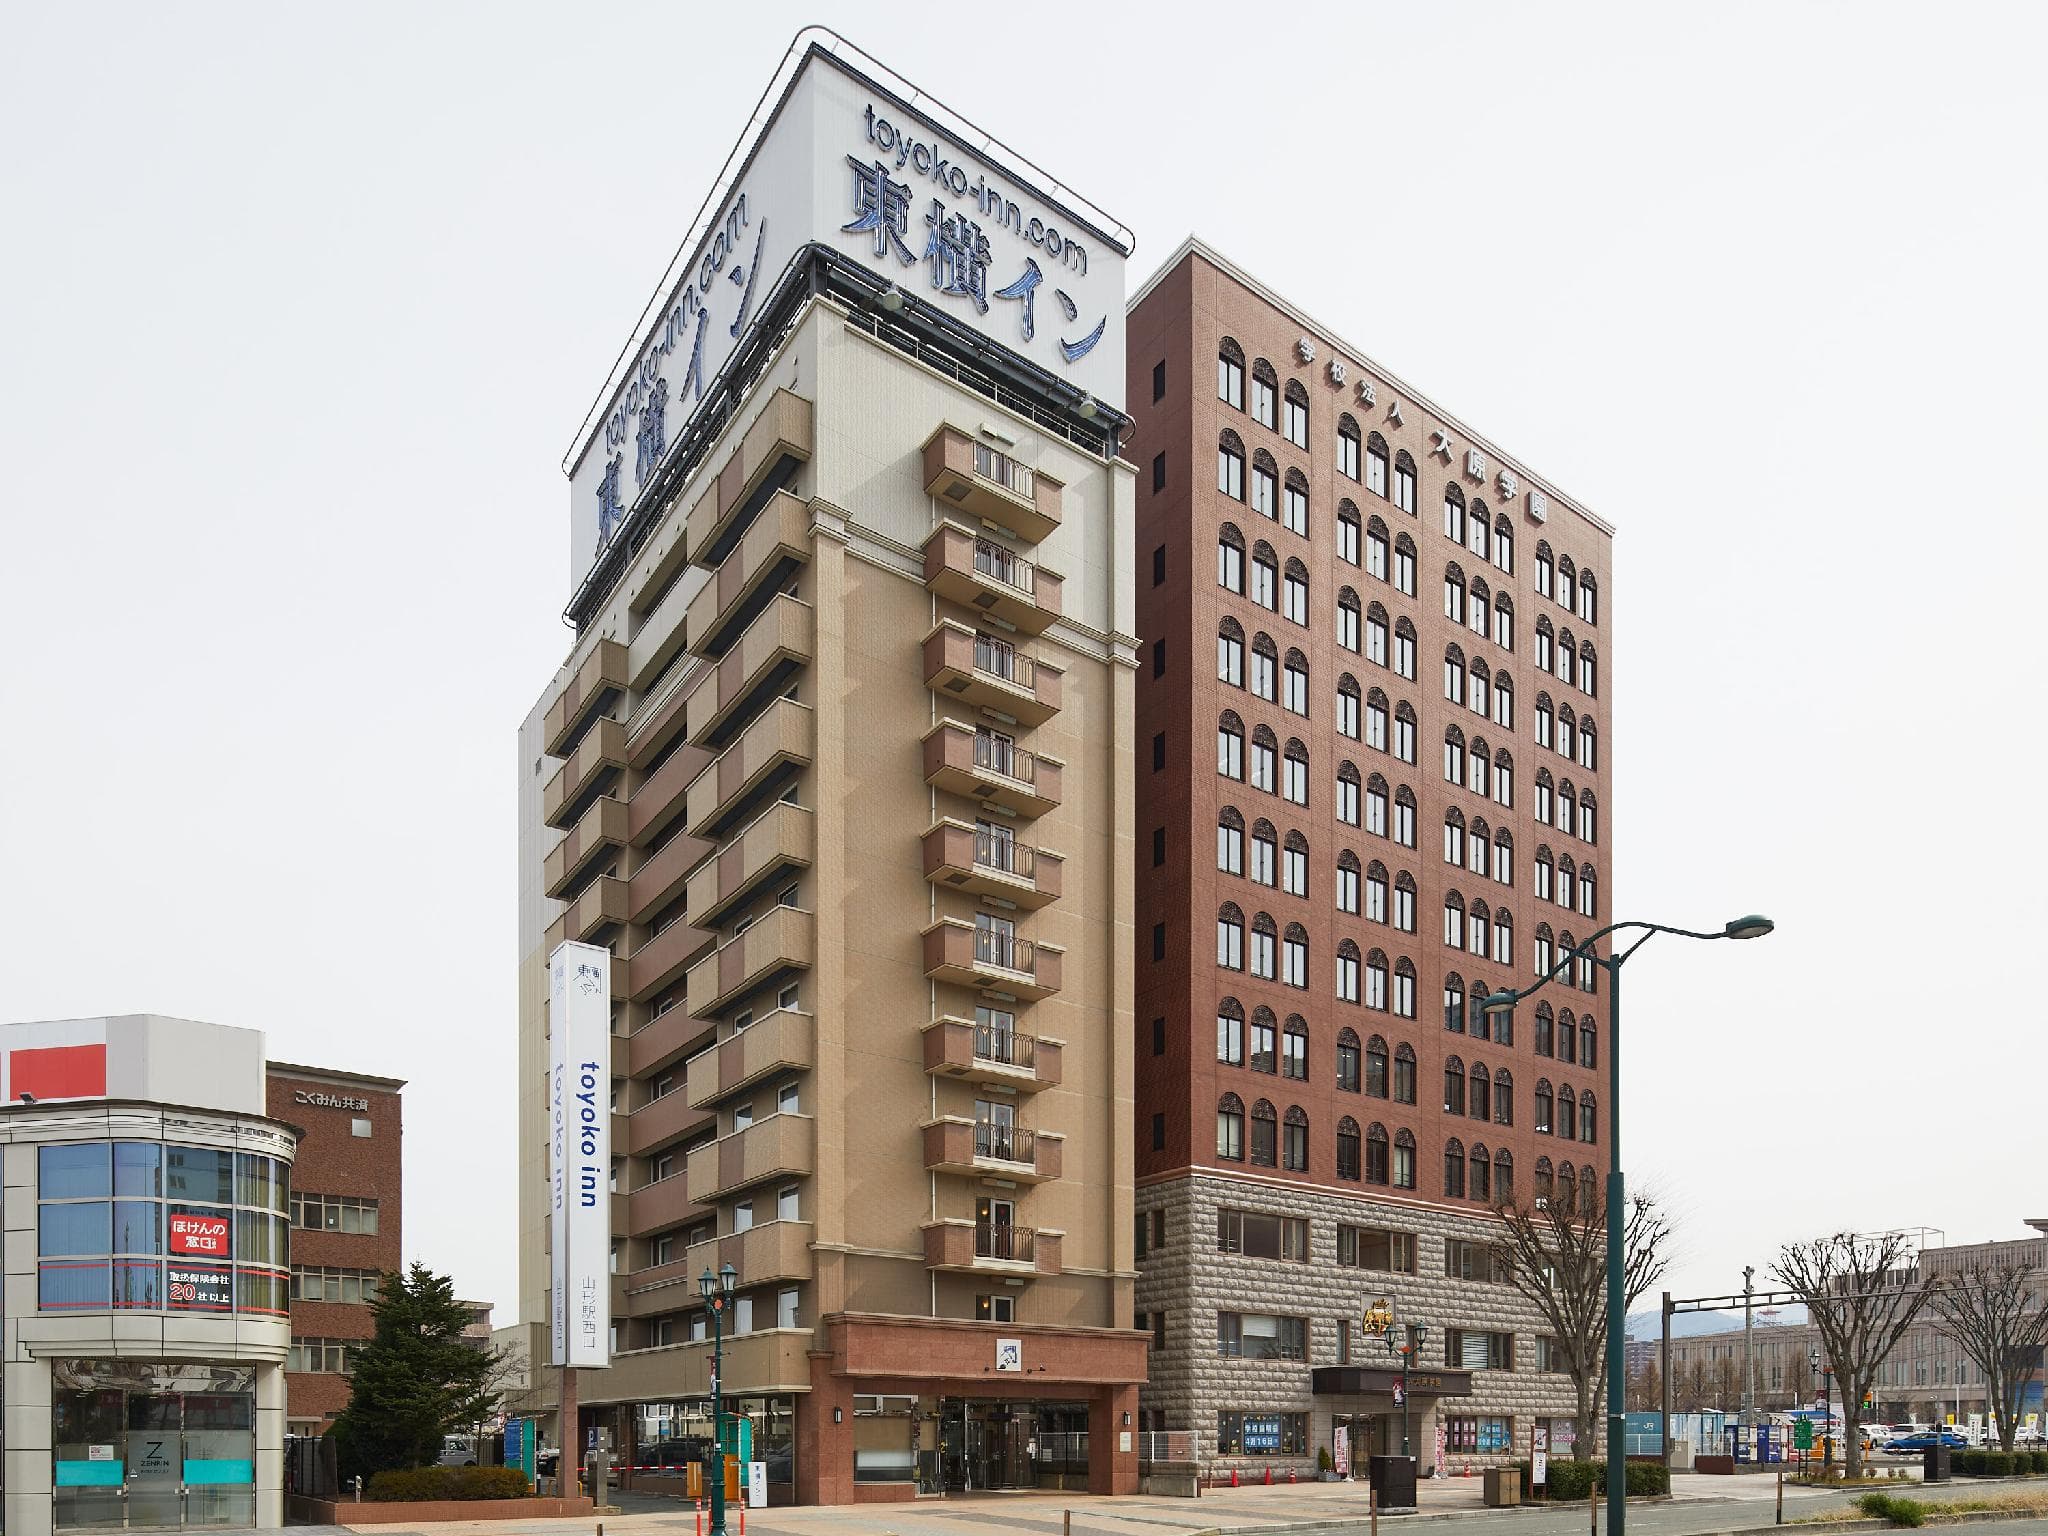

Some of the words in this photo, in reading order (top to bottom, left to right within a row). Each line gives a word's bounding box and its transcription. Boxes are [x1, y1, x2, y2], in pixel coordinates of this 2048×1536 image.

[864, 103, 1087, 276] toyoko-inn.com
[840, 153, 1107, 364] 東横イン
[606, 192, 749, 455] toyoko-inn.com
[295, 1089, 369, 1112] こくみん共済
[554, 1062, 564, 1158] toyoko
[576, 1061, 601, 1156] toyoko
[555, 1168, 563, 1210] inn
[581, 1166, 601, 1207] inn
[173, 1220, 226, 1235] ほけんの
[582, 1275, 597, 1349] 山形駅西口
[1643, 1422, 1655, 1431] JR
